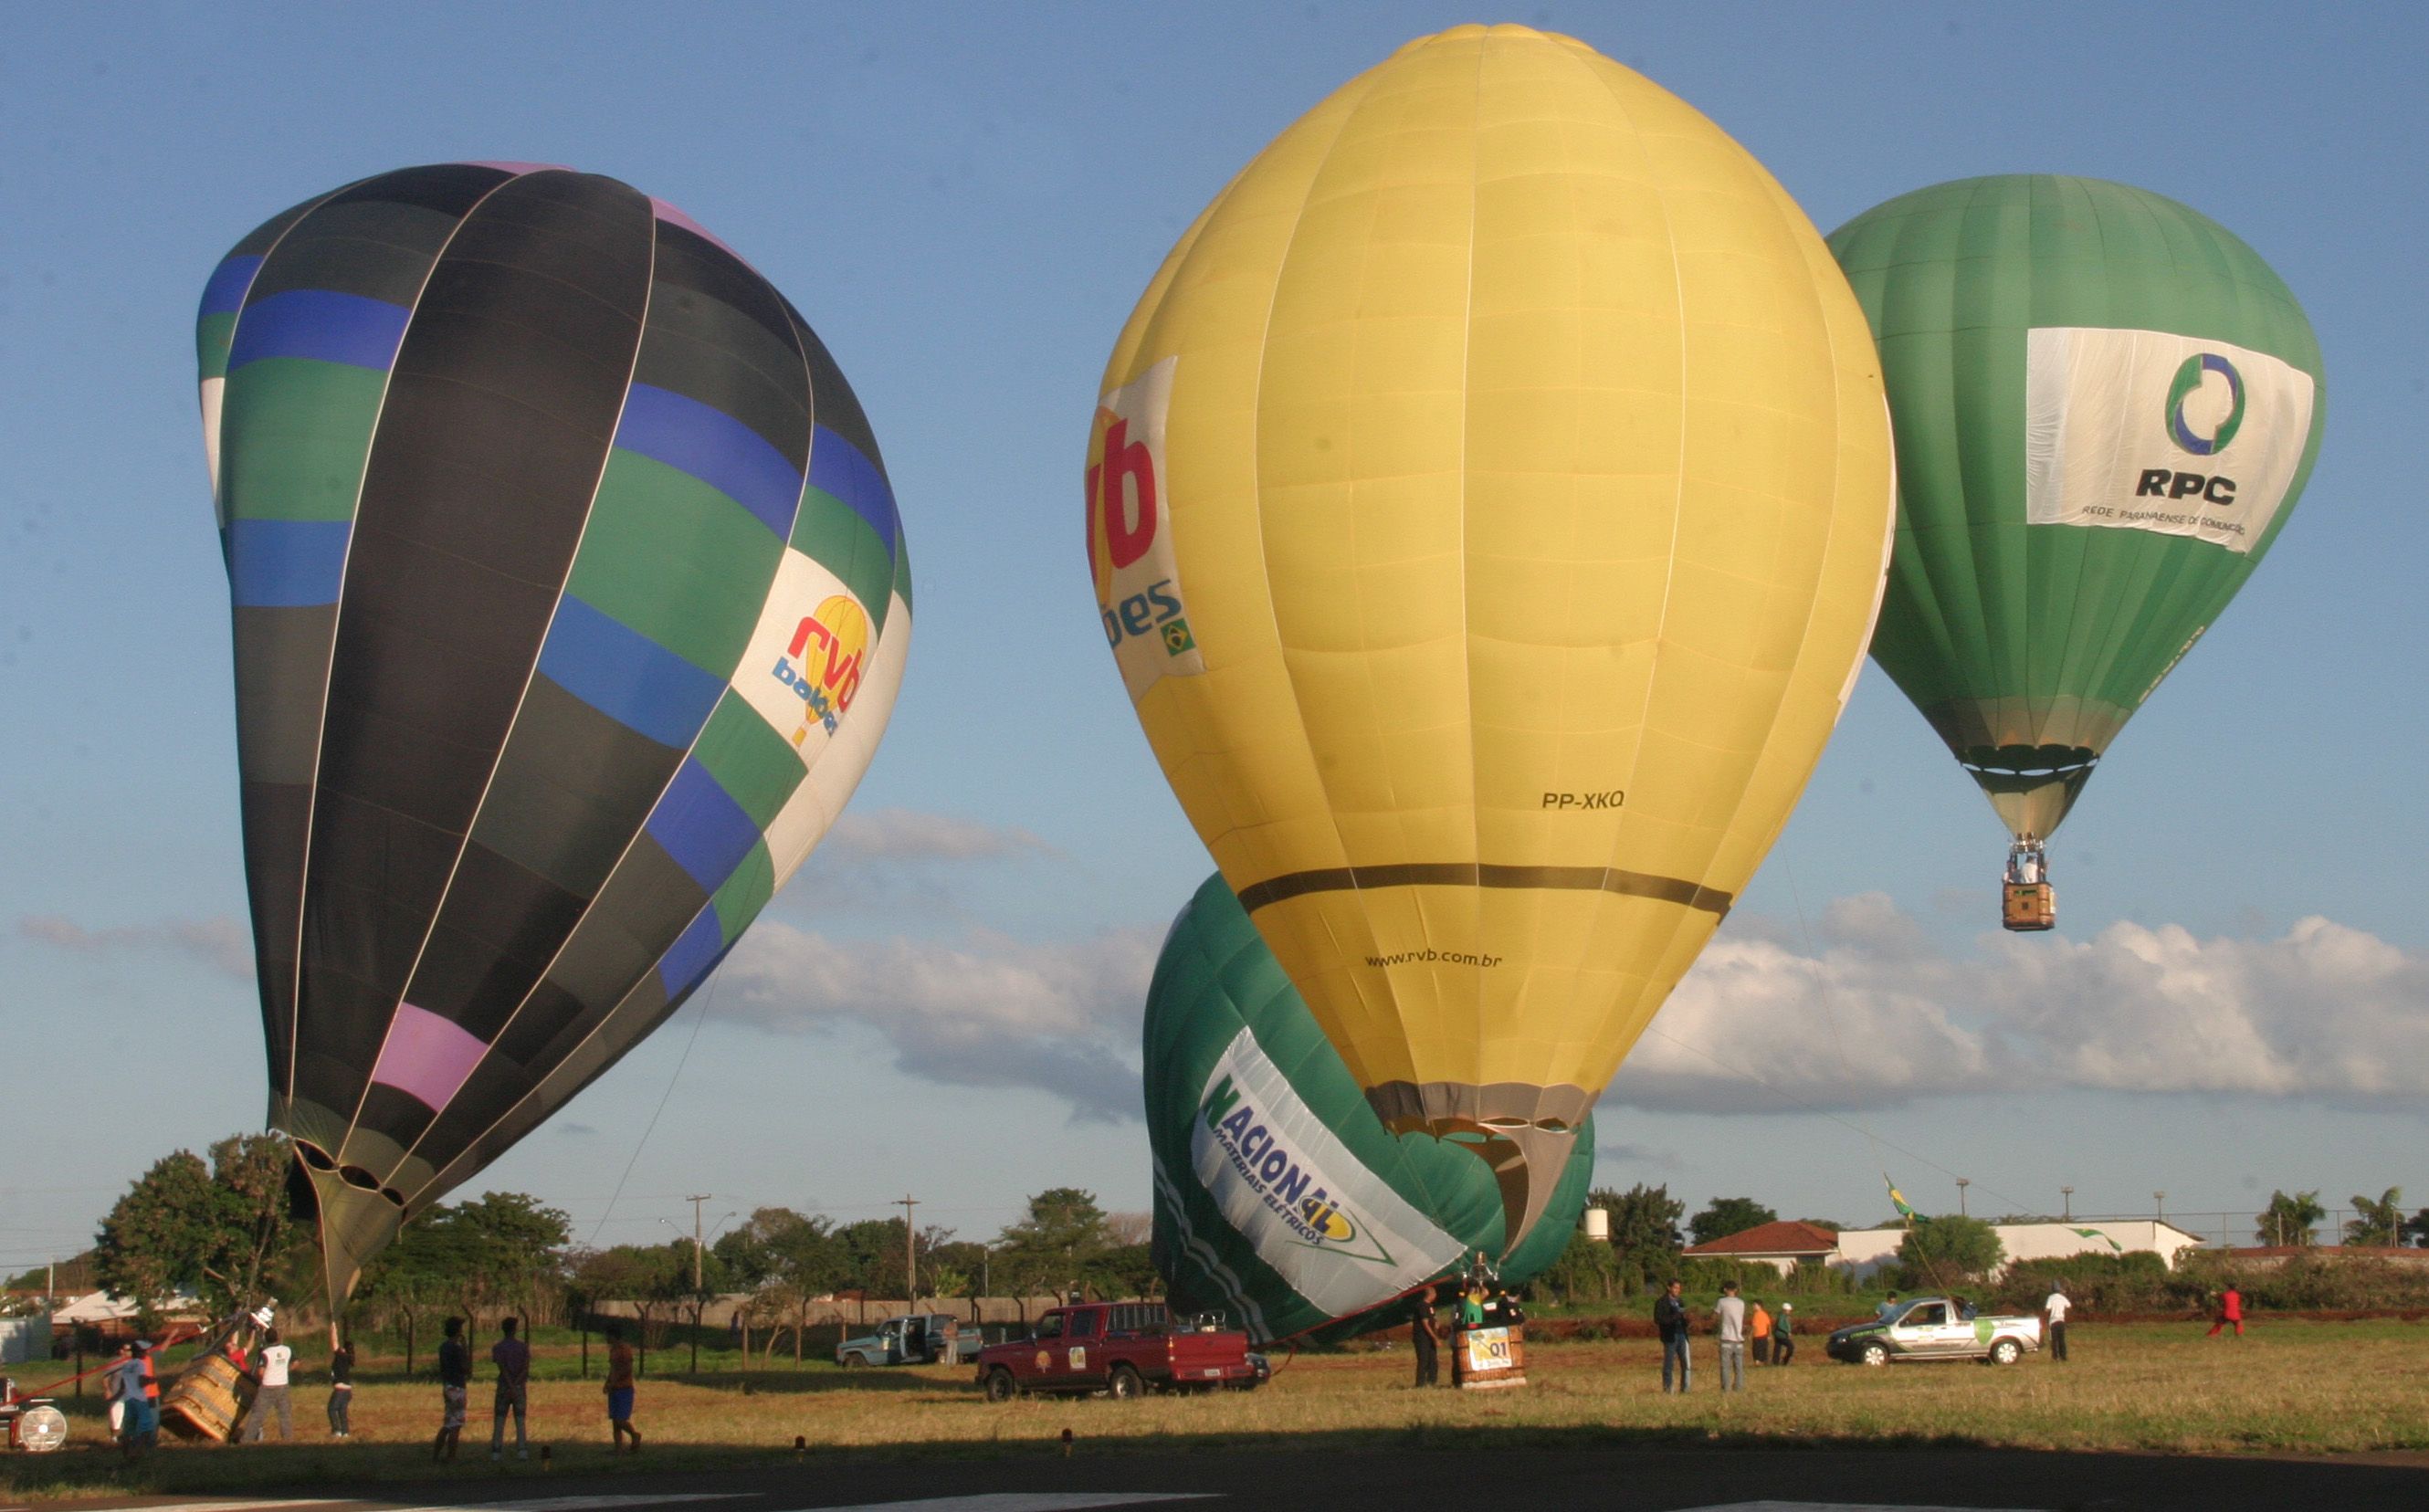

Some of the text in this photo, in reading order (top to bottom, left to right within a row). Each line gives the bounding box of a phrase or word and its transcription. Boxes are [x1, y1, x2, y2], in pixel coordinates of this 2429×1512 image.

[2135, 468, 2236, 507] RPC
[2082, 505, 2115, 519] REDE
[788, 616, 862, 713] rvb
[1365, 948, 1503, 968] www.rvb.com.br
[1202, 1073, 1341, 1234] NACIONAL
[1213, 1128, 1326, 1246] MATERIAIS ELÉTRICOS
[1489, 1342, 1507, 1357] 01
